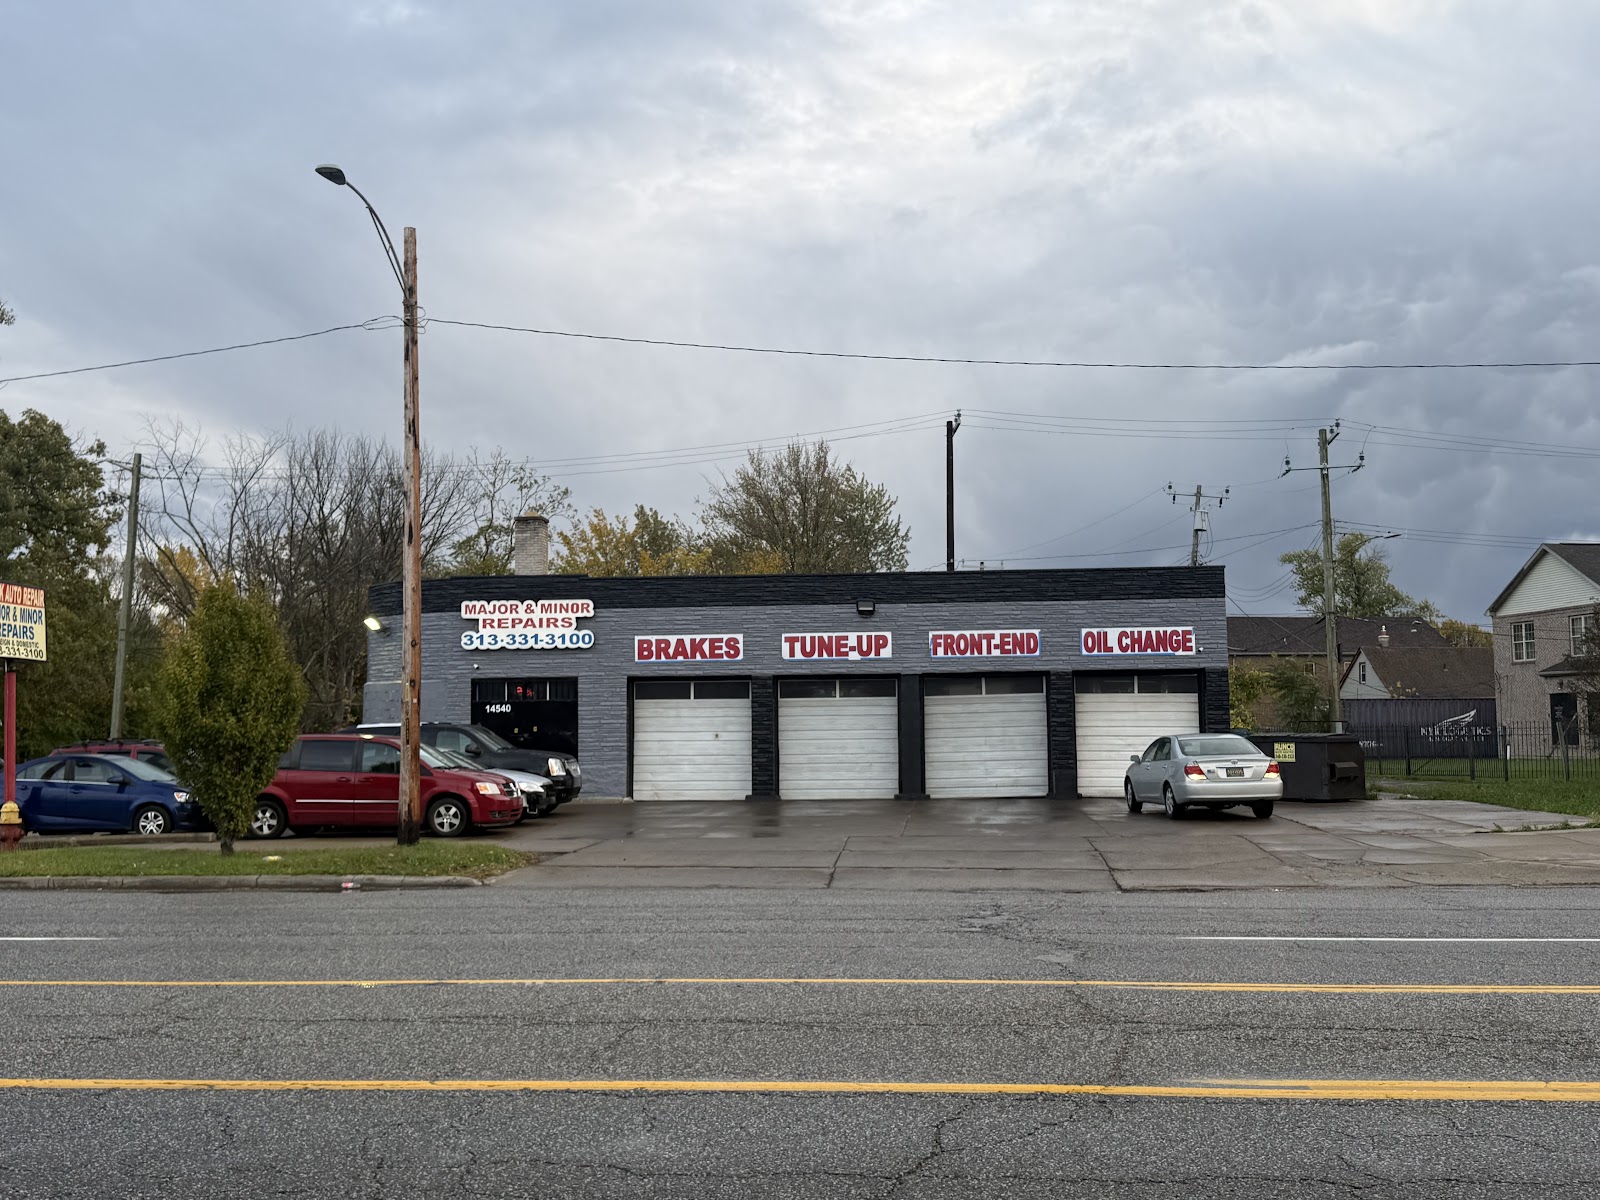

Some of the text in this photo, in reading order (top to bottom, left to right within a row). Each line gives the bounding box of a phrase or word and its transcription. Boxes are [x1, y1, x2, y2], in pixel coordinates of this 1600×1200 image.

[5, 584, 22, 604] AUTO
[22, 587, 44, 607] REPAIR
[12, 606, 17, 622] &
[20, 608, 43, 625] MINOR
[464, 602, 590, 614] MAJOR & MINOR
[0, 623, 34, 640] EPAIRS
[482, 617, 573, 628] REPAIRS
[16, 640, 39, 649] DOMESTIC
[637, 637, 740, 660] BRAKES
[784, 634, 888, 658] TUNE-UP
[932, 632, 1038, 656] FRONT-END
[1084, 630, 1194, 653] OIL CHANGE
[485, 704, 511, 713] 14540
